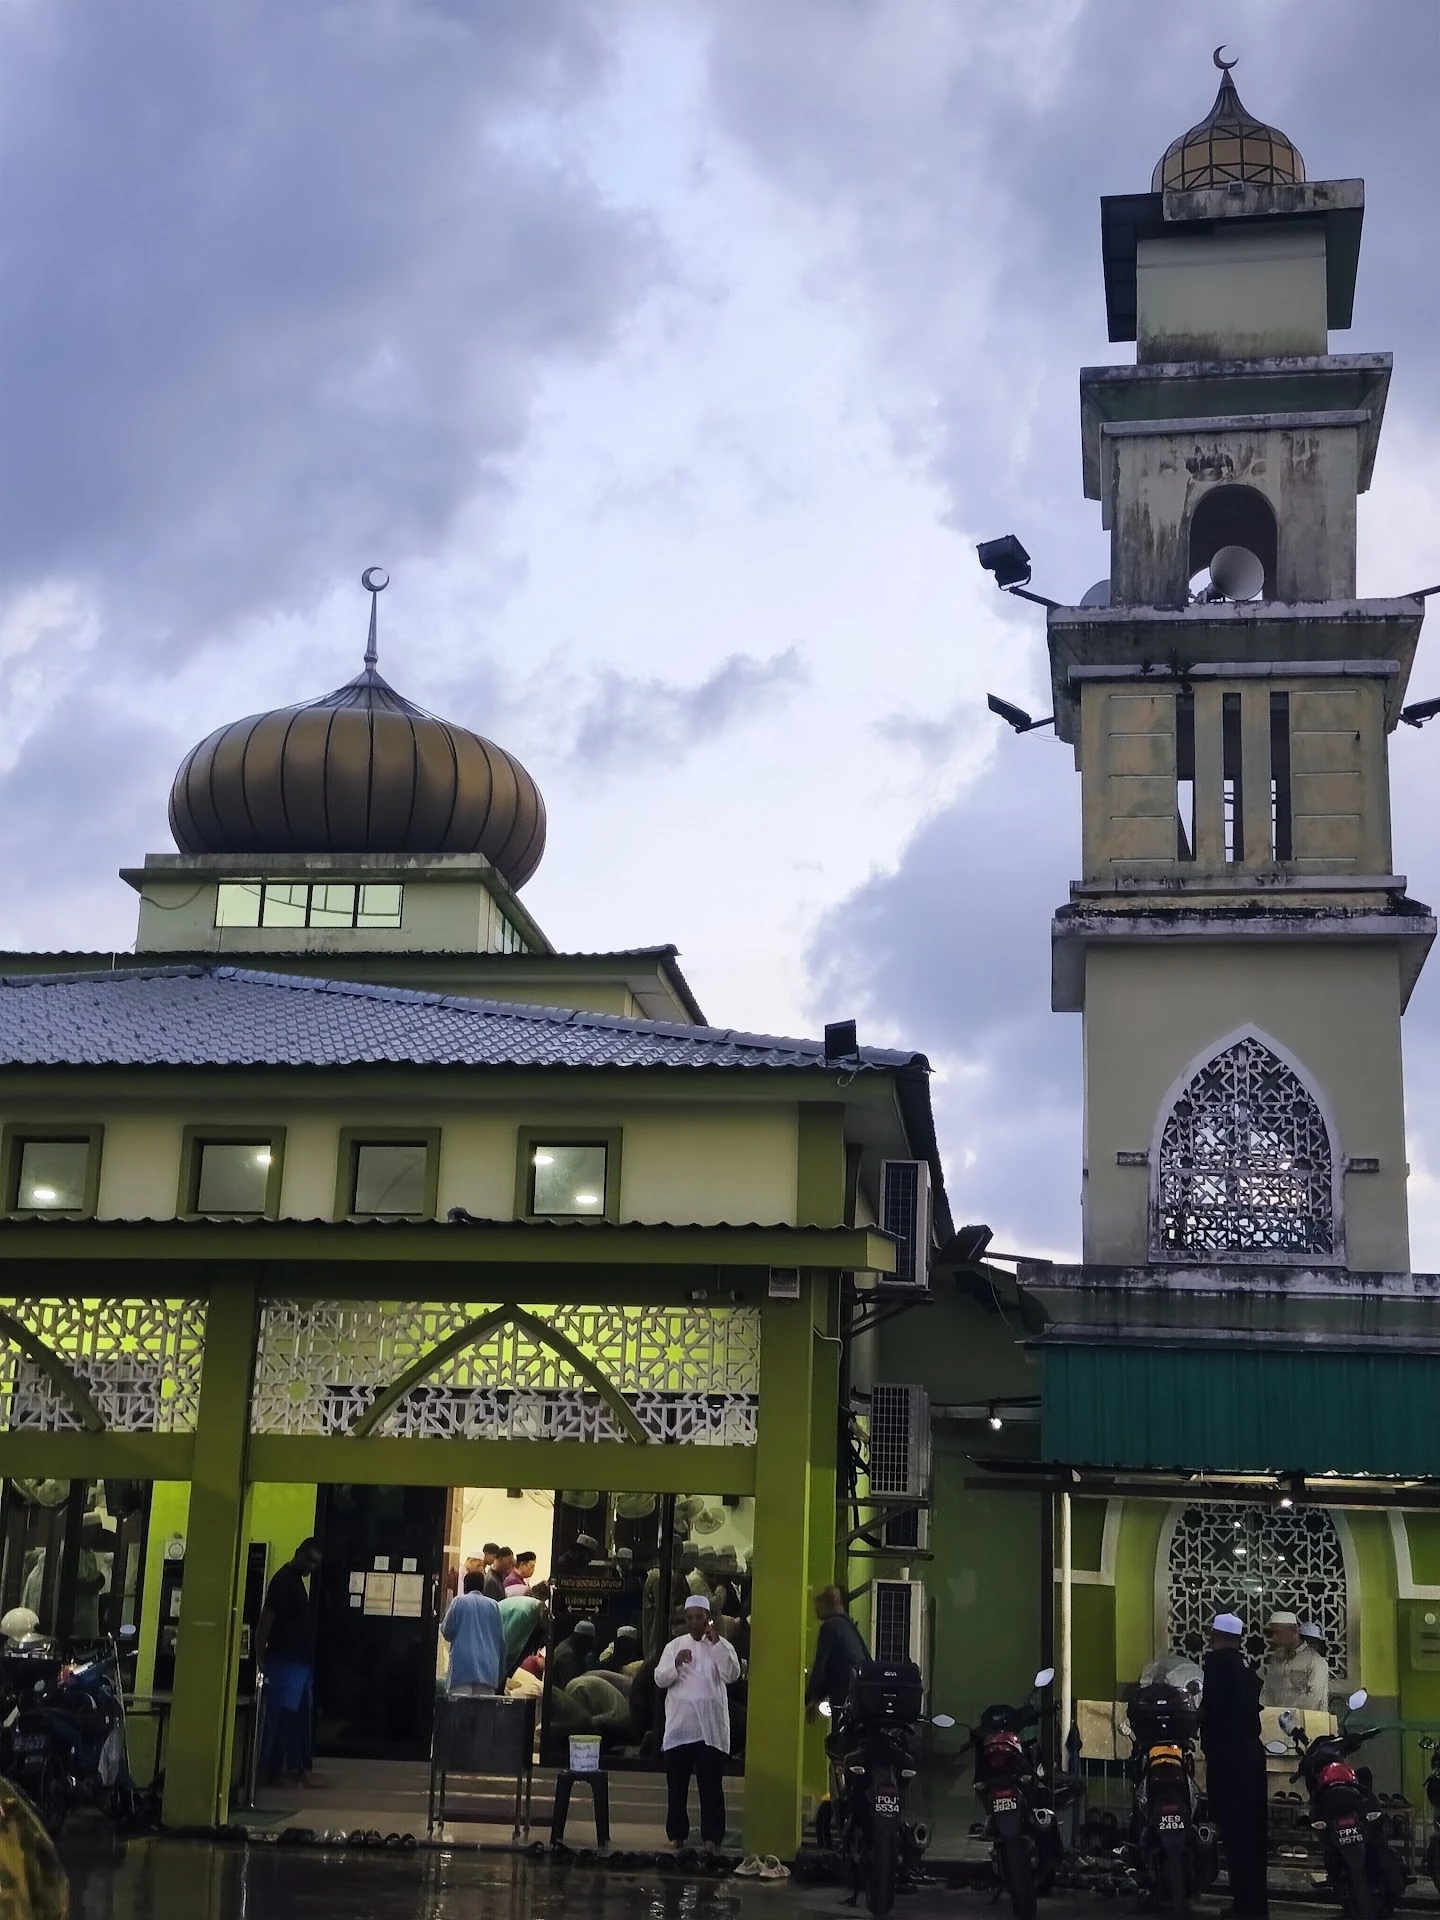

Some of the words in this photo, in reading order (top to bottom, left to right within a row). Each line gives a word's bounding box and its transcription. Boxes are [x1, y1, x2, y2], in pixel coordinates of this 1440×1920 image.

[878, 1796, 896, 1805] PQJ
[876, 1804, 899, 1812] 5534
[1339, 1827, 1358, 1836] PPX
[1339, 1834, 1363, 1844] 9576
